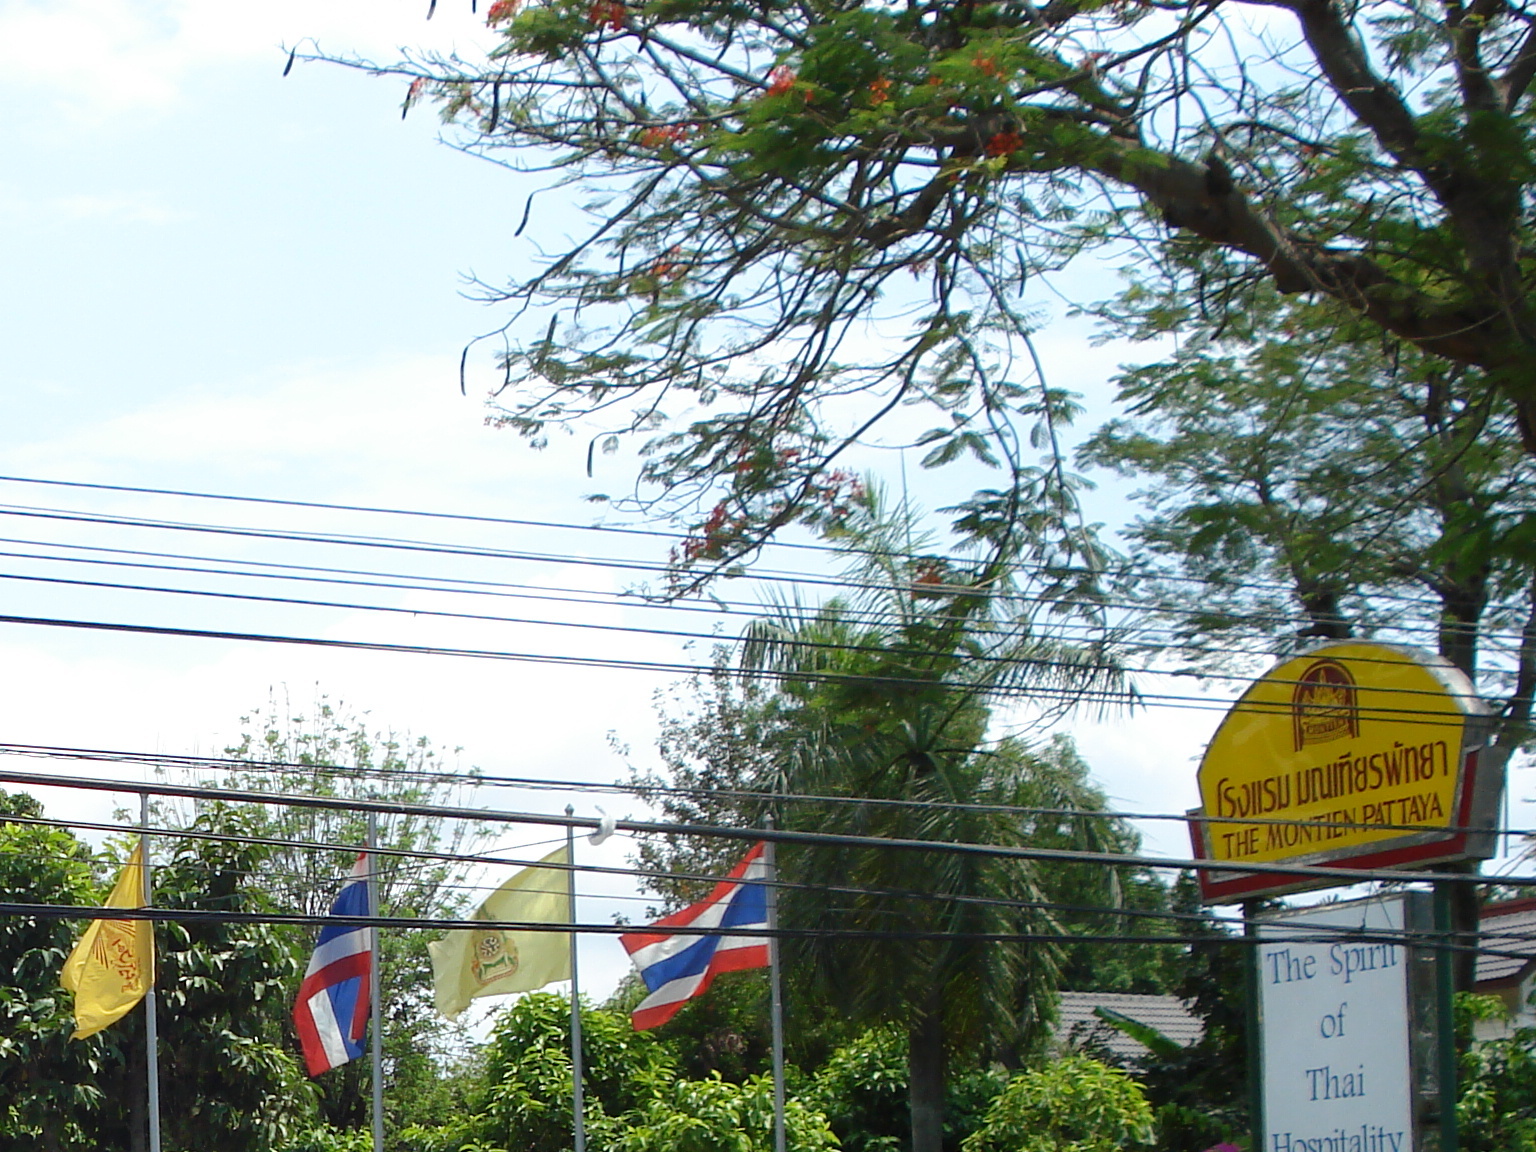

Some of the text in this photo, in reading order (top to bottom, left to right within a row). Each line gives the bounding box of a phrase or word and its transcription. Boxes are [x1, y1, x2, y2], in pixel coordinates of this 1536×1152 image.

[1223, 792, 1444, 859] THE MONTIEN PATTAYA
[1267, 943, 1397, 984] The Spirit
[1320, 1001, 1347, 1038] of
[1306, 1064, 1366, 1101] Thai
